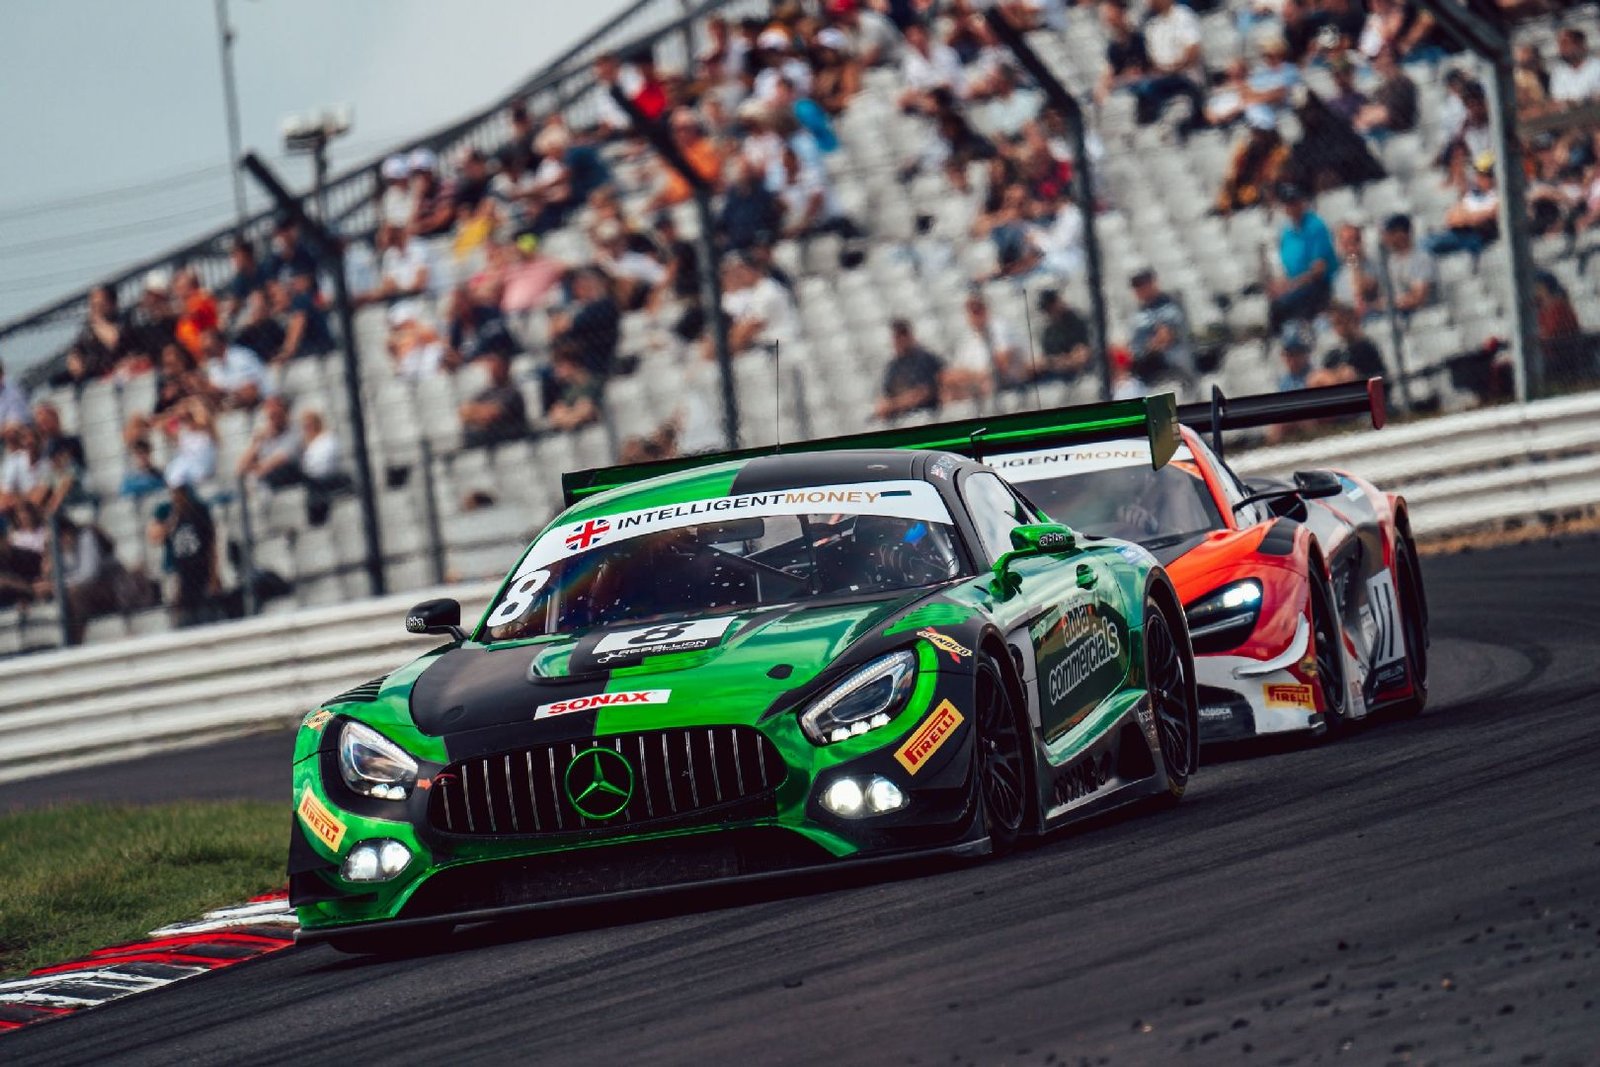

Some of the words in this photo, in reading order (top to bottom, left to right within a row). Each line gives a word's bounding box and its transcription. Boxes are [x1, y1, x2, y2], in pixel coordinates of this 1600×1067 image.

[1040, 532, 1065, 546] abba
[487, 570, 550, 627] 8
[628, 623, 696, 644] 8
[919, 630, 970, 656] SUNOCO
[1049, 616, 1120, 706] commercials
[548, 691, 651, 714] SONAX
[1267, 685, 1311, 704] PIRELLI
[903, 708, 956, 766] PIRELLI
[302, 796, 340, 843] PIRELLI
